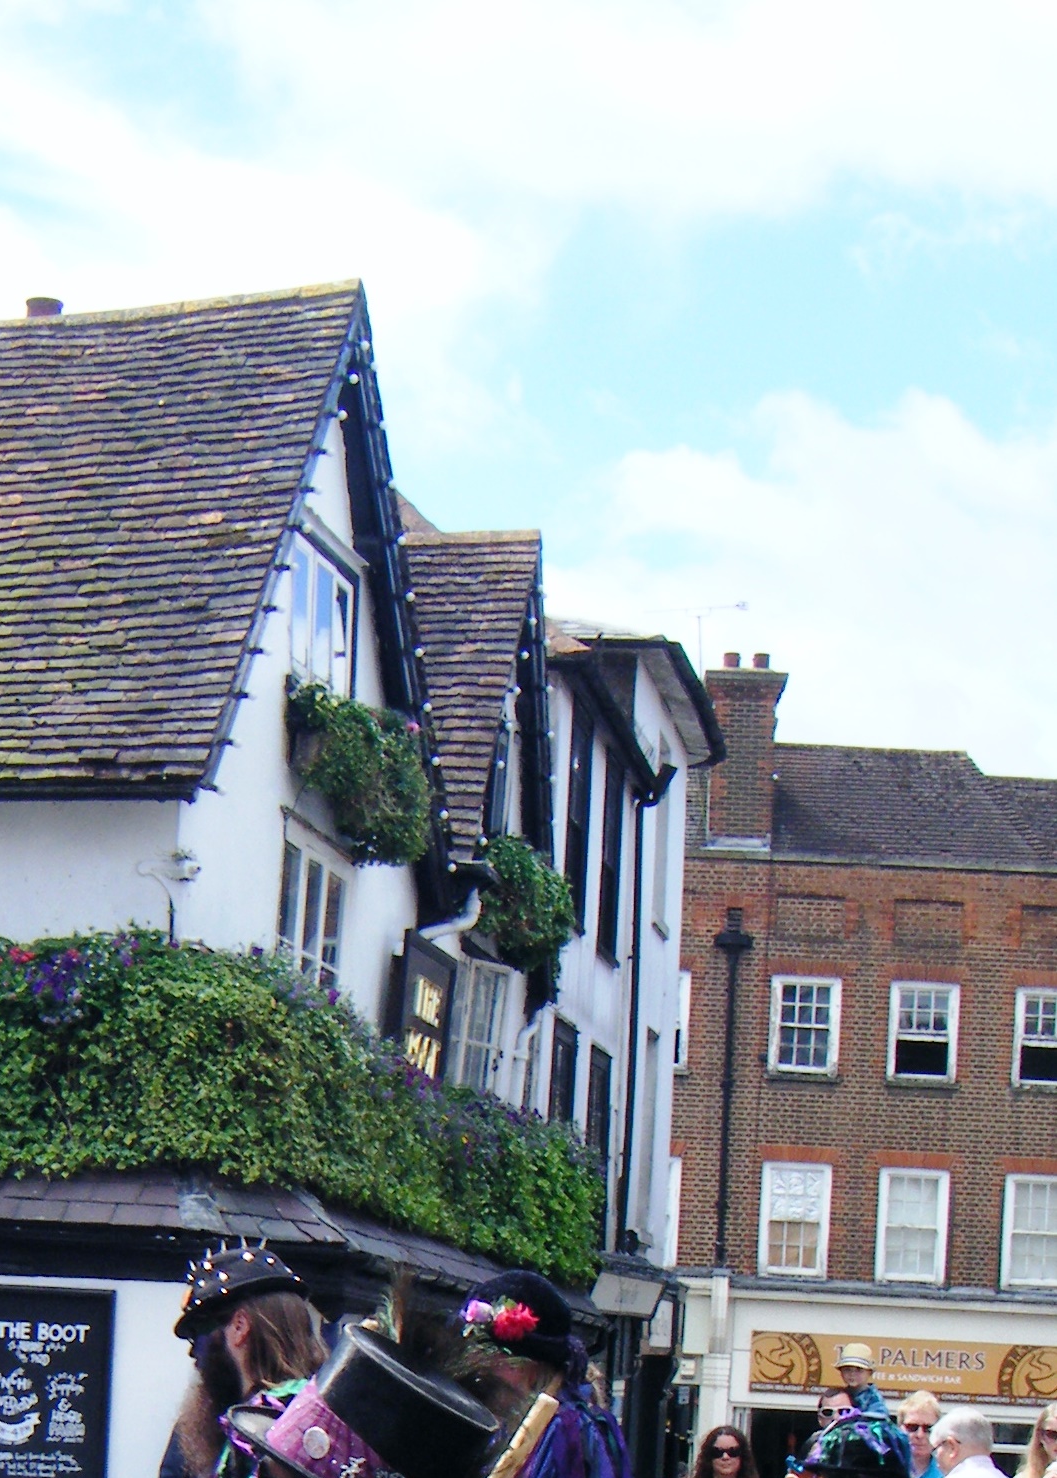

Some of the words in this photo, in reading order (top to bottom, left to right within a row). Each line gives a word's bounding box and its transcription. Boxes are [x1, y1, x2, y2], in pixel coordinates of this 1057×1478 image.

[37, 1322, 91, 1343] BOOT
[879, 1346, 985, 1372] PALMERS
[896, 1373, 942, 1384] SANDWICH
[944, 1375, 962, 1384] BAR
